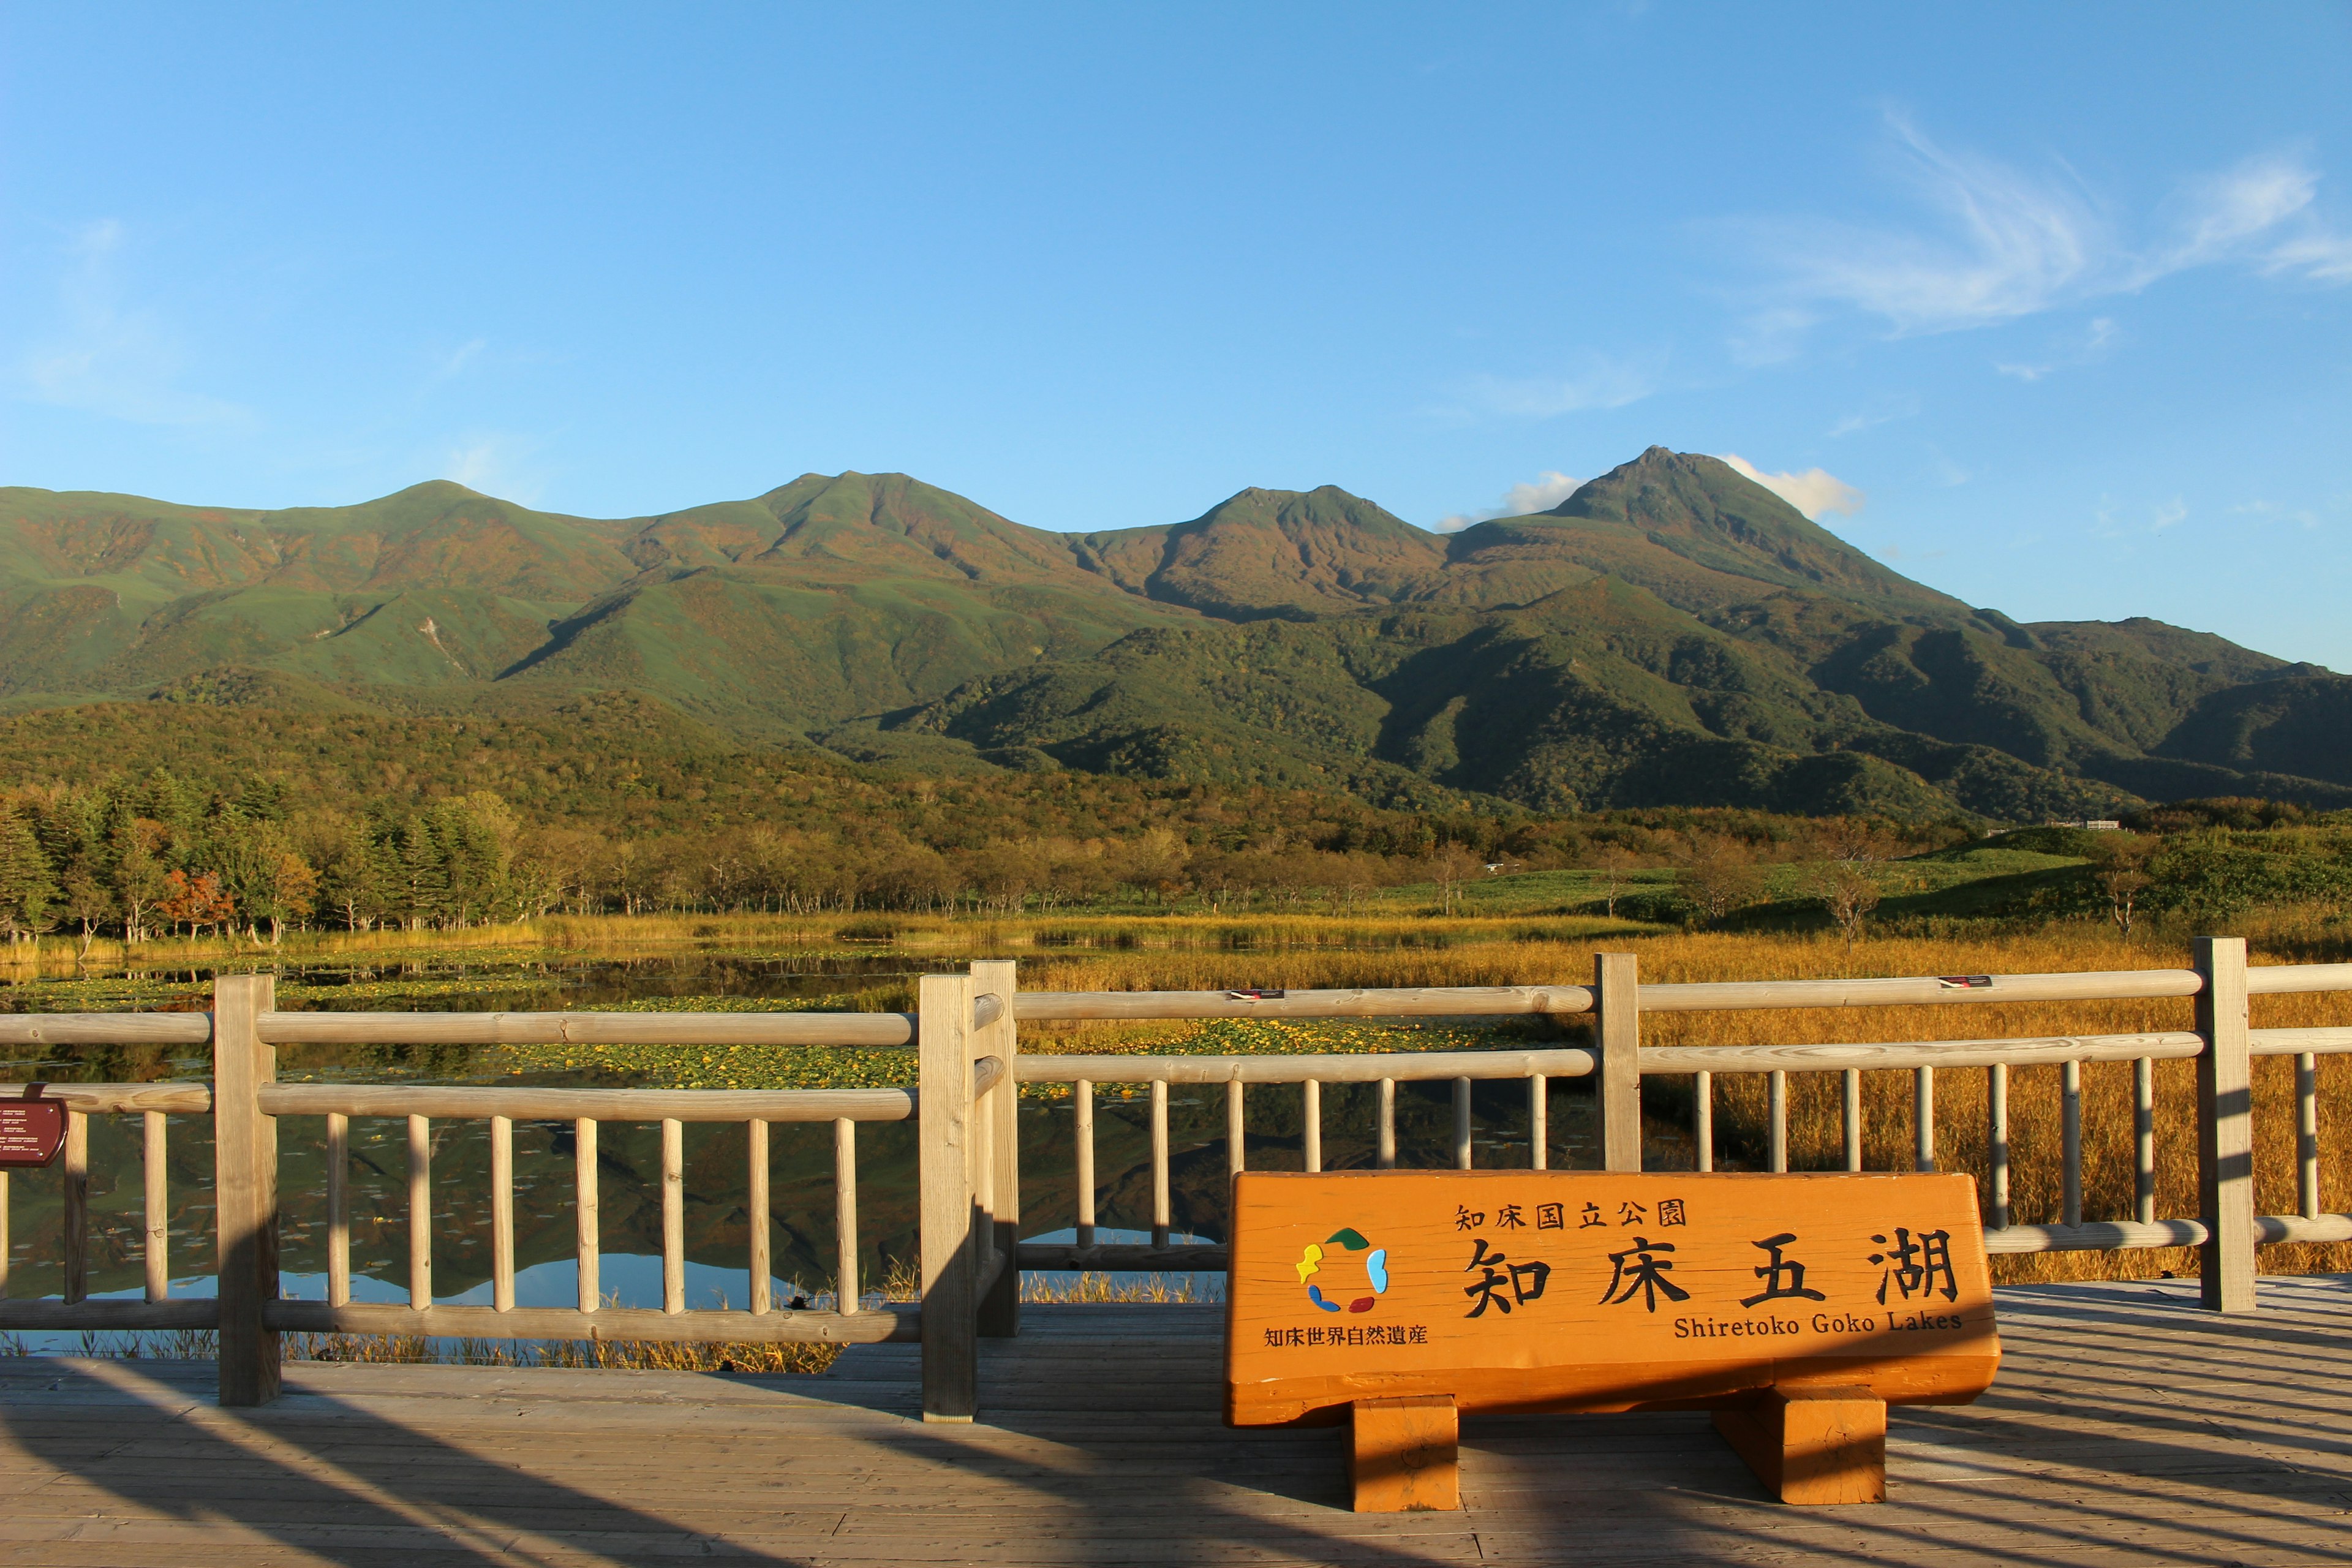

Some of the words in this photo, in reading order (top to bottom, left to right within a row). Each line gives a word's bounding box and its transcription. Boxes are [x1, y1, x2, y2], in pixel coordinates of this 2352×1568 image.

[1455, 1199, 1686, 1231] 知床国立公園
[1461, 1227, 1958, 1318] 知床五湖
[1264, 1325, 1428, 1348] 知床世界自然遺産
[1674, 1315, 1800, 1338] Shiretoko
[1812, 1313, 1875, 1333] Goko
[1887, 1311, 1962, 1332] Lakes
